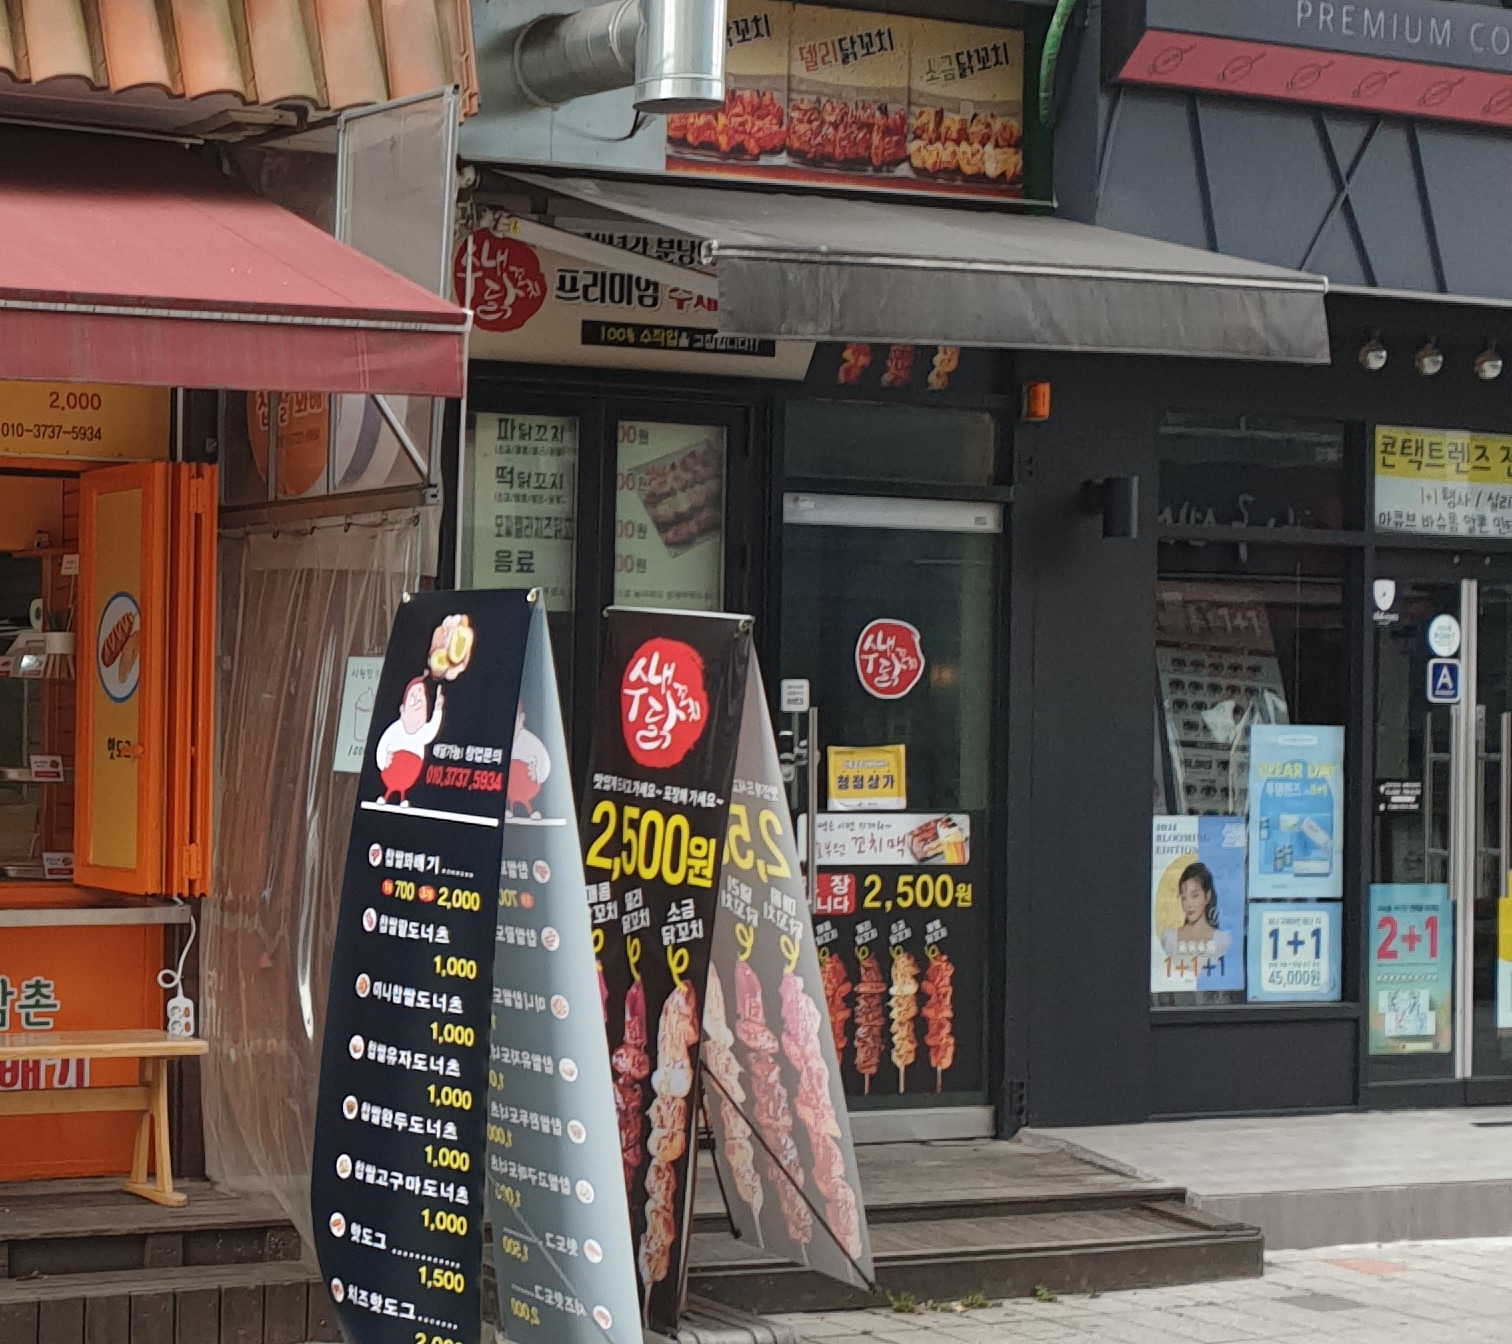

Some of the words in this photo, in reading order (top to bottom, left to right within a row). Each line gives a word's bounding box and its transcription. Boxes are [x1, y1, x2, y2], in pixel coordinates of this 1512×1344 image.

[555, 268, 660, 308] 프리미엄
[2, 422, 102, 441] 010-3737-5934
[1381, 435, 1491, 474] 콘택트렌즈
[494, 550, 535, 574] 음료
[586, 800, 716, 888] 2,500원
[395, 880, 415, 901] 700
[437, 887, 480, 912] 2,000
[863, 873, 972, 913] 2,500원
[667, 898, 695, 922] 소금
[661, 919, 704, 946] 닭꼬치
[1269, 927, 1322, 961] 1+1
[1376, 915, 1438, 961] 2+1
[434, 955, 477, 980] 1,000
[1164, 956, 1225, 978] 1+1+1
[1268, 969, 1321, 988] 45,000원
[373, 981, 463, 1014] 미니찹쌀도너츠
[430, 1021, 474, 1047] 1,000
[367, 1040, 461, 1077] 찹쌀유자도너츠
[427, 1084, 472, 1110] 1,000
[424, 1144, 470, 1172] 1,000
[355, 1159, 469, 1205] 찹쌀고구마도너츠
[350, 1222, 387, 1250] 핫도그
[421, 1208, 468, 1236] 1,000
[418, 1265, 465, 1293] 1,500
